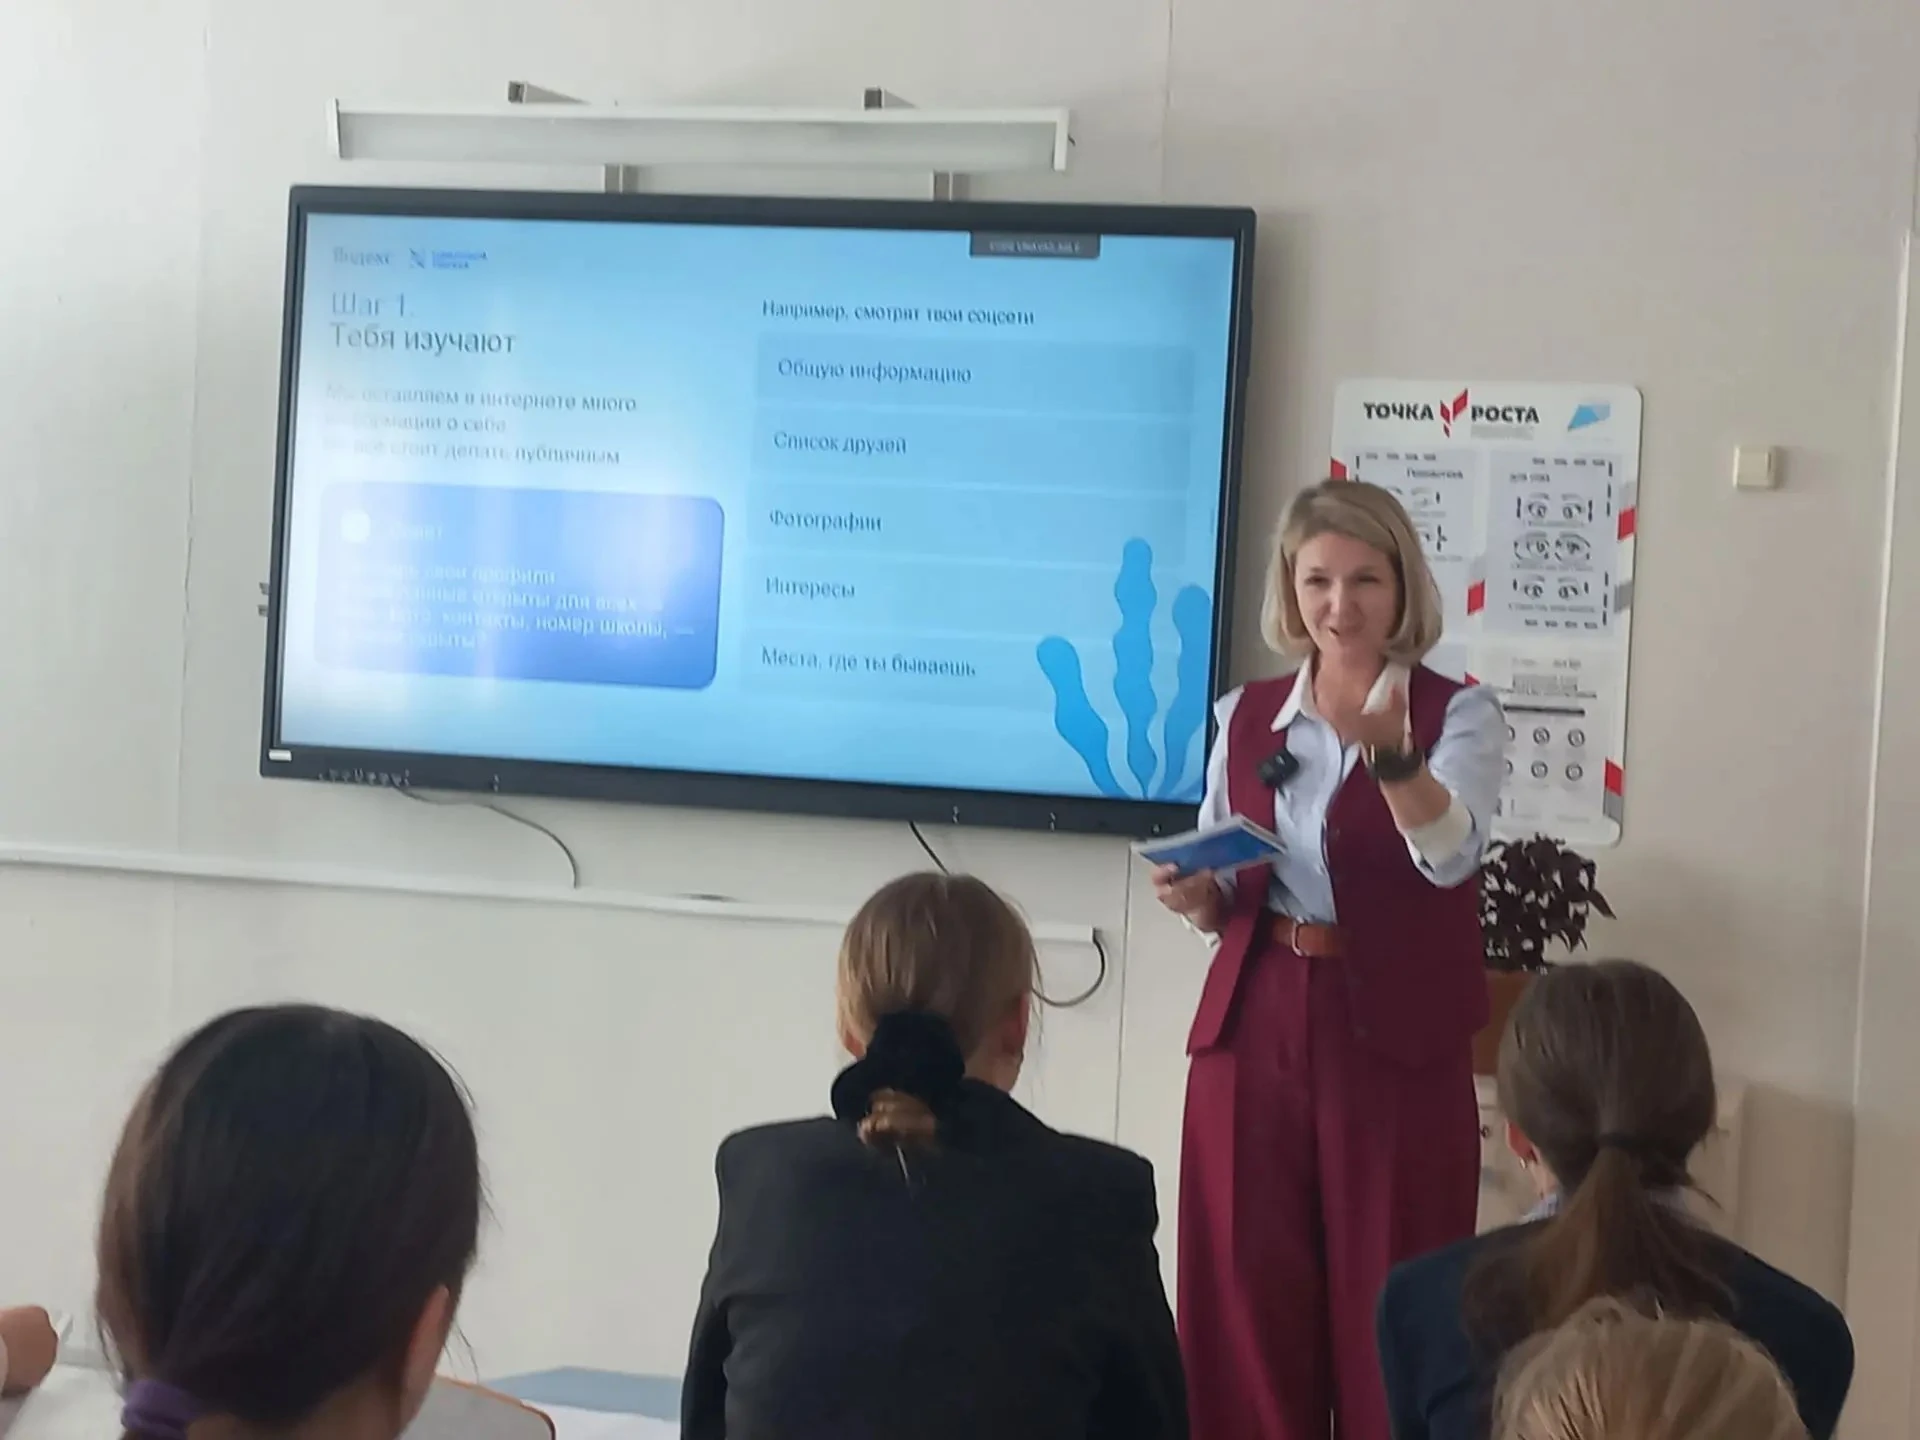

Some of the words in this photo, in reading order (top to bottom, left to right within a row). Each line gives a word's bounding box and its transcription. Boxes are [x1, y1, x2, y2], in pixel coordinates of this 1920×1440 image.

[762, 299, 848, 321] Например,
[968, 309, 1034, 327] соцсети
[331, 322, 395, 350] Тебя
[404, 331, 516, 357] изучают
[778, 358, 844, 381] Общую
[850, 361, 972, 385] информацию
[582, 395, 637, 411] много
[1363, 402, 1434, 420] ТОЧКА
[1471, 405, 1540, 424] РОСТА
[774, 431, 839, 451] Список
[842, 434, 907, 456] друзей
[770, 509, 882, 533] Фотографии
[766, 577, 855, 599] Интересы
[761, 646, 823, 669] Места,
[864, 657, 887, 673] ты
[892, 654, 976, 677] бываешь
